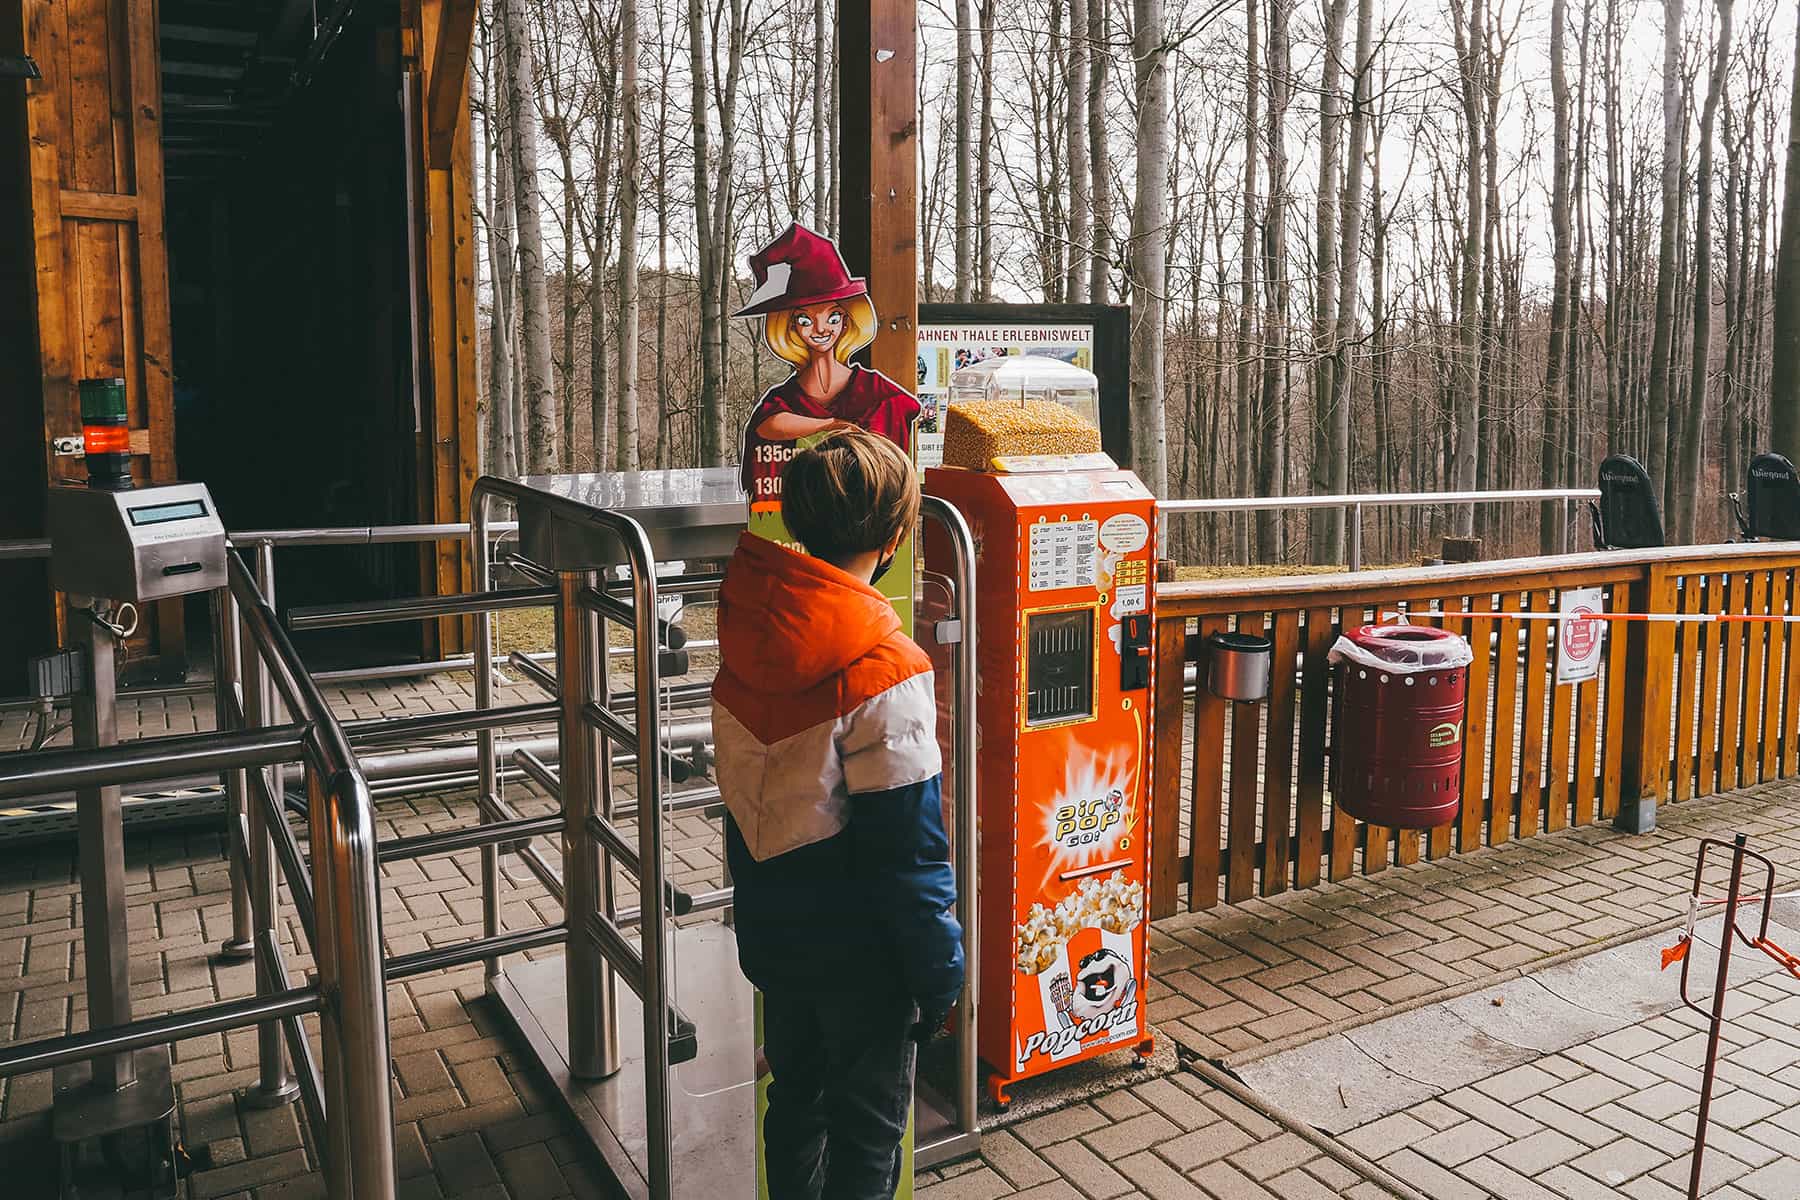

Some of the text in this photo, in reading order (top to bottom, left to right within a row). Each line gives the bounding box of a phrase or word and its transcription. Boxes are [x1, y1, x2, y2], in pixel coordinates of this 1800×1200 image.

[963, 329, 998, 342] THALE
[1002, 329, 1092, 342] ERLEBNISWELT
[755, 476, 782, 495] 130
[1100, 594, 1107, 604] 3
[1056, 800, 1103, 821] air
[1056, 809, 1120, 841] pop
[1066, 831, 1100, 847] GO!
[1018, 1001, 1138, 1064] Popcorn
